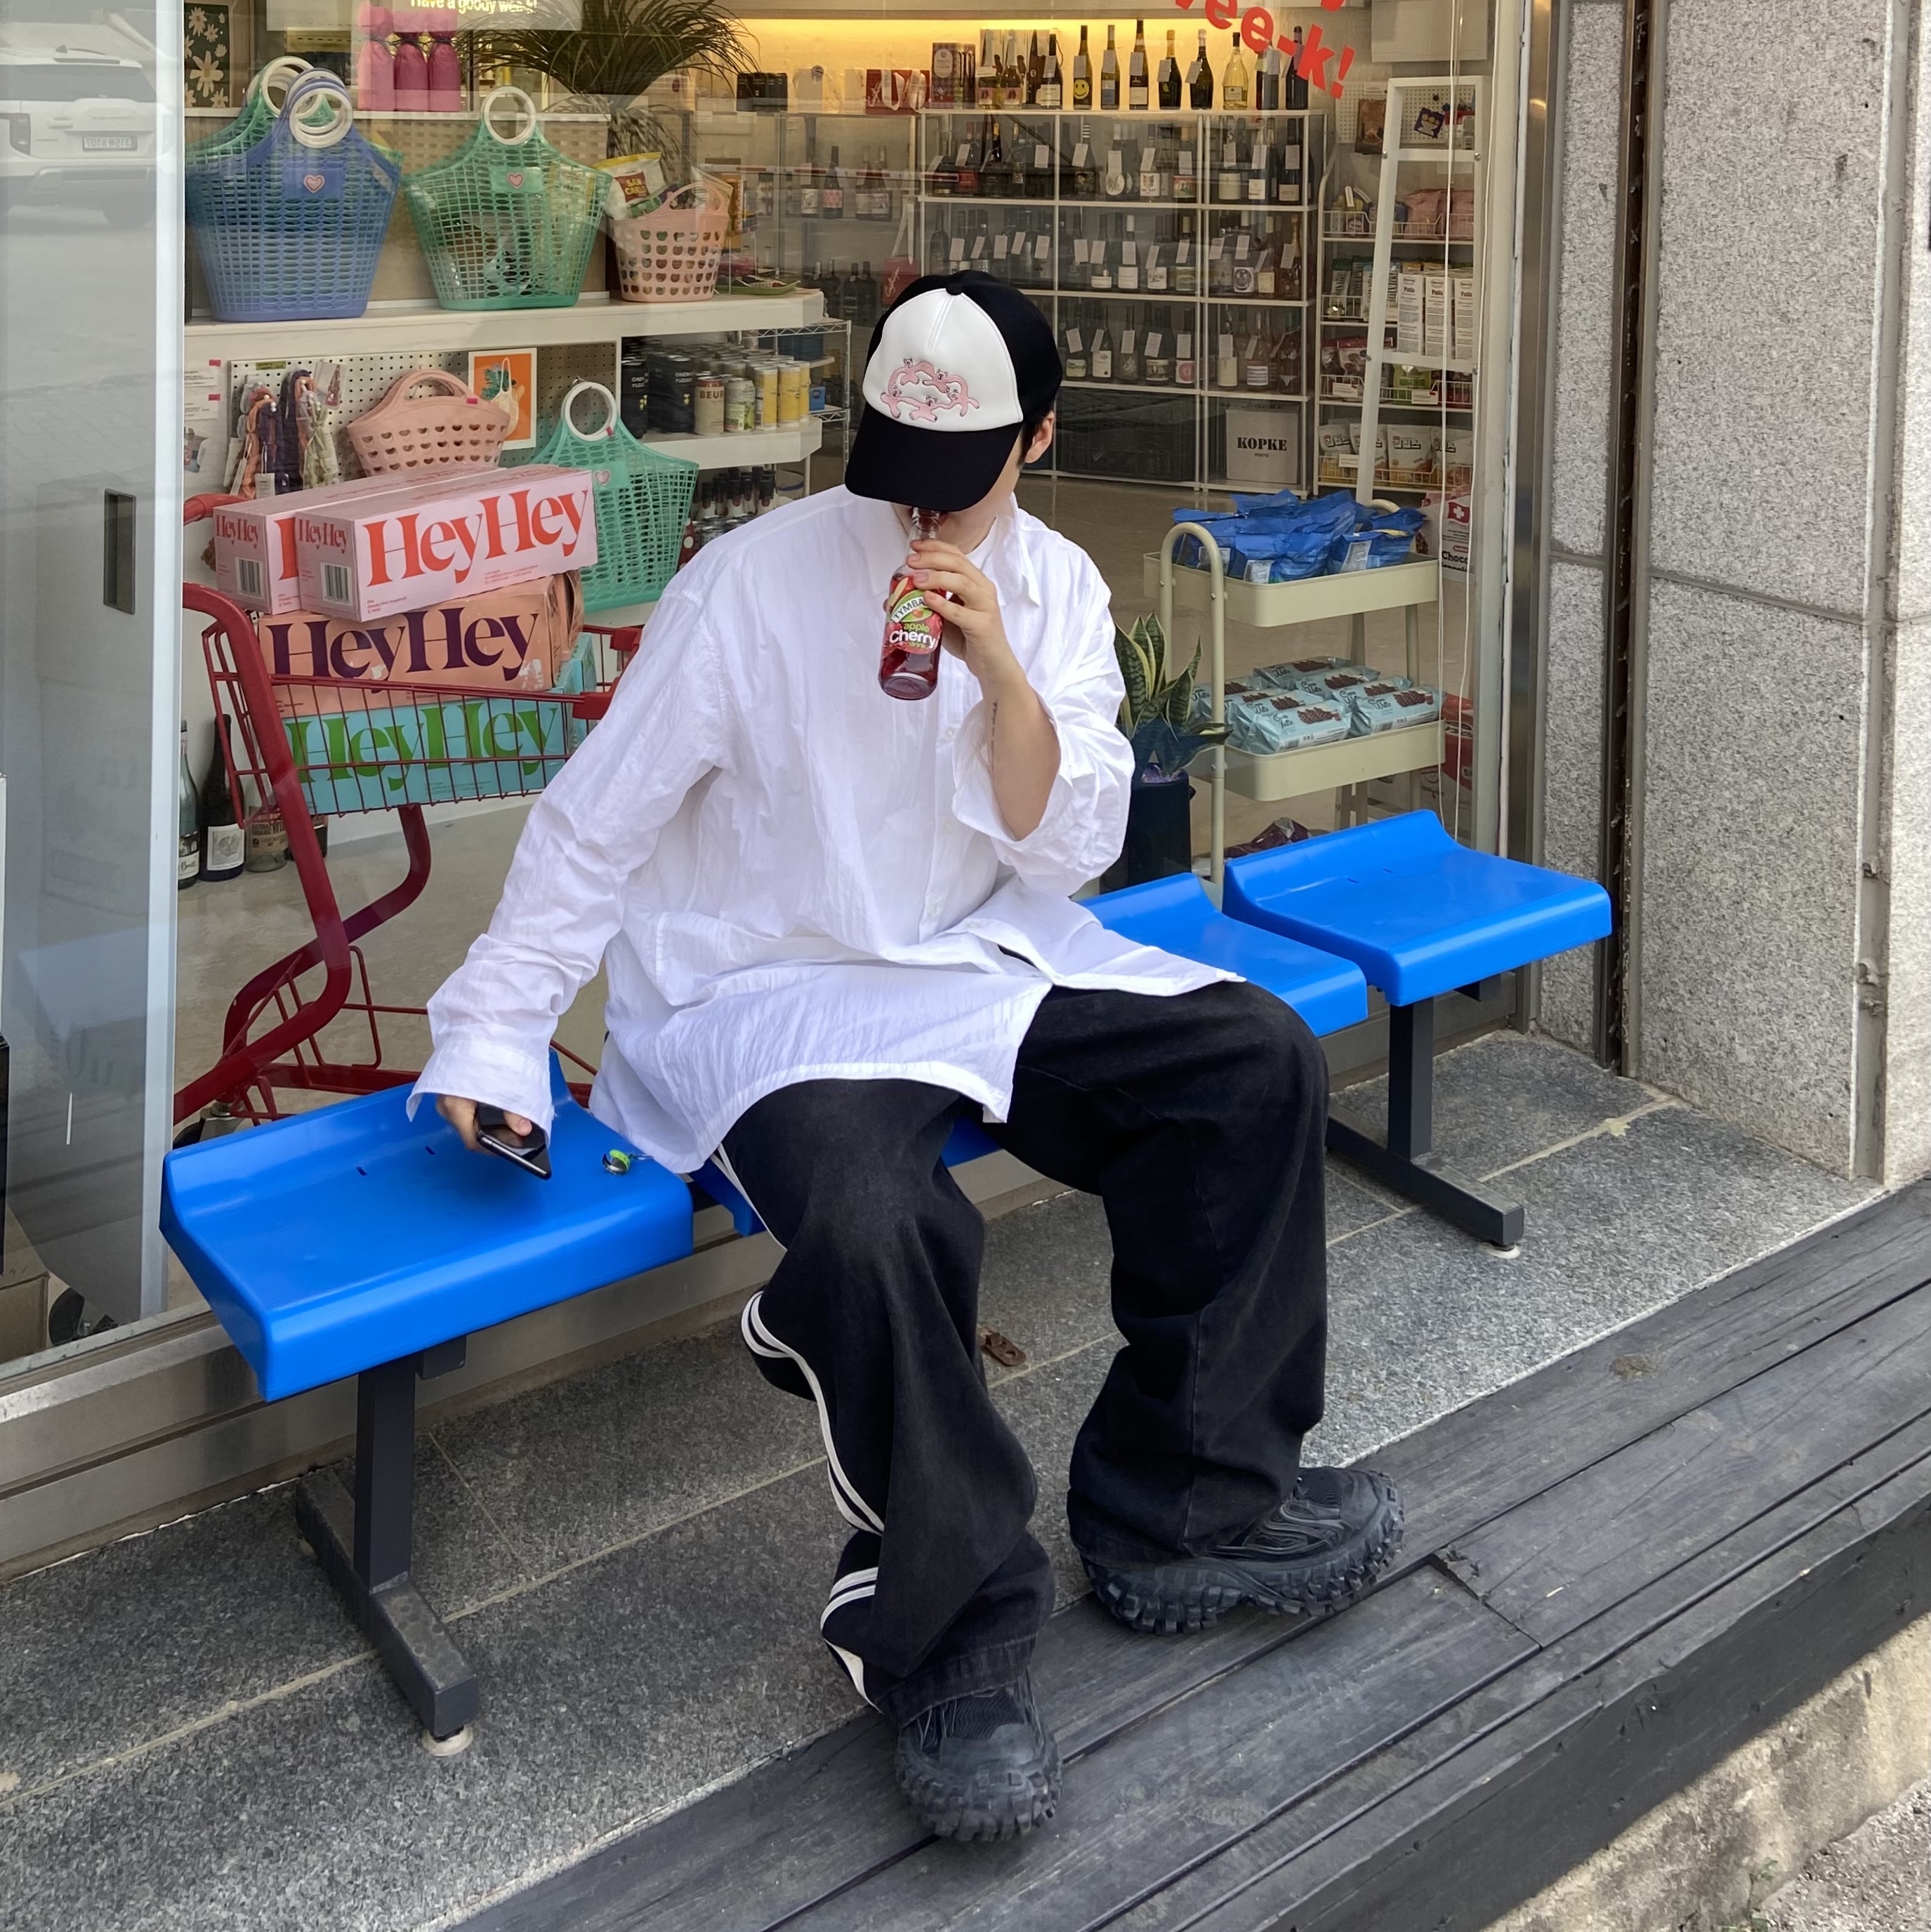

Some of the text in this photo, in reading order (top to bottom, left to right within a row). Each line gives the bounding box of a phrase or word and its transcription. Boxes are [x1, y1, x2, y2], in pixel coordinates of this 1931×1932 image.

[1175, 0, 1355, 99] ee-k!
[625, 185, 647, 195] CARLO
[1237, 437, 1287, 451] KOPKE
[216, 514, 261, 549] HeyHey
[298, 519, 348, 555] HeyHey
[362, 489, 589, 587] HeyHey
[893, 597, 925, 619] TYMBA
[889, 629, 937, 649] Cherry
[903, 623, 930, 633] apple
[265, 607, 540, 694] HeyHey
[284, 701, 559, 793] HeyHey
